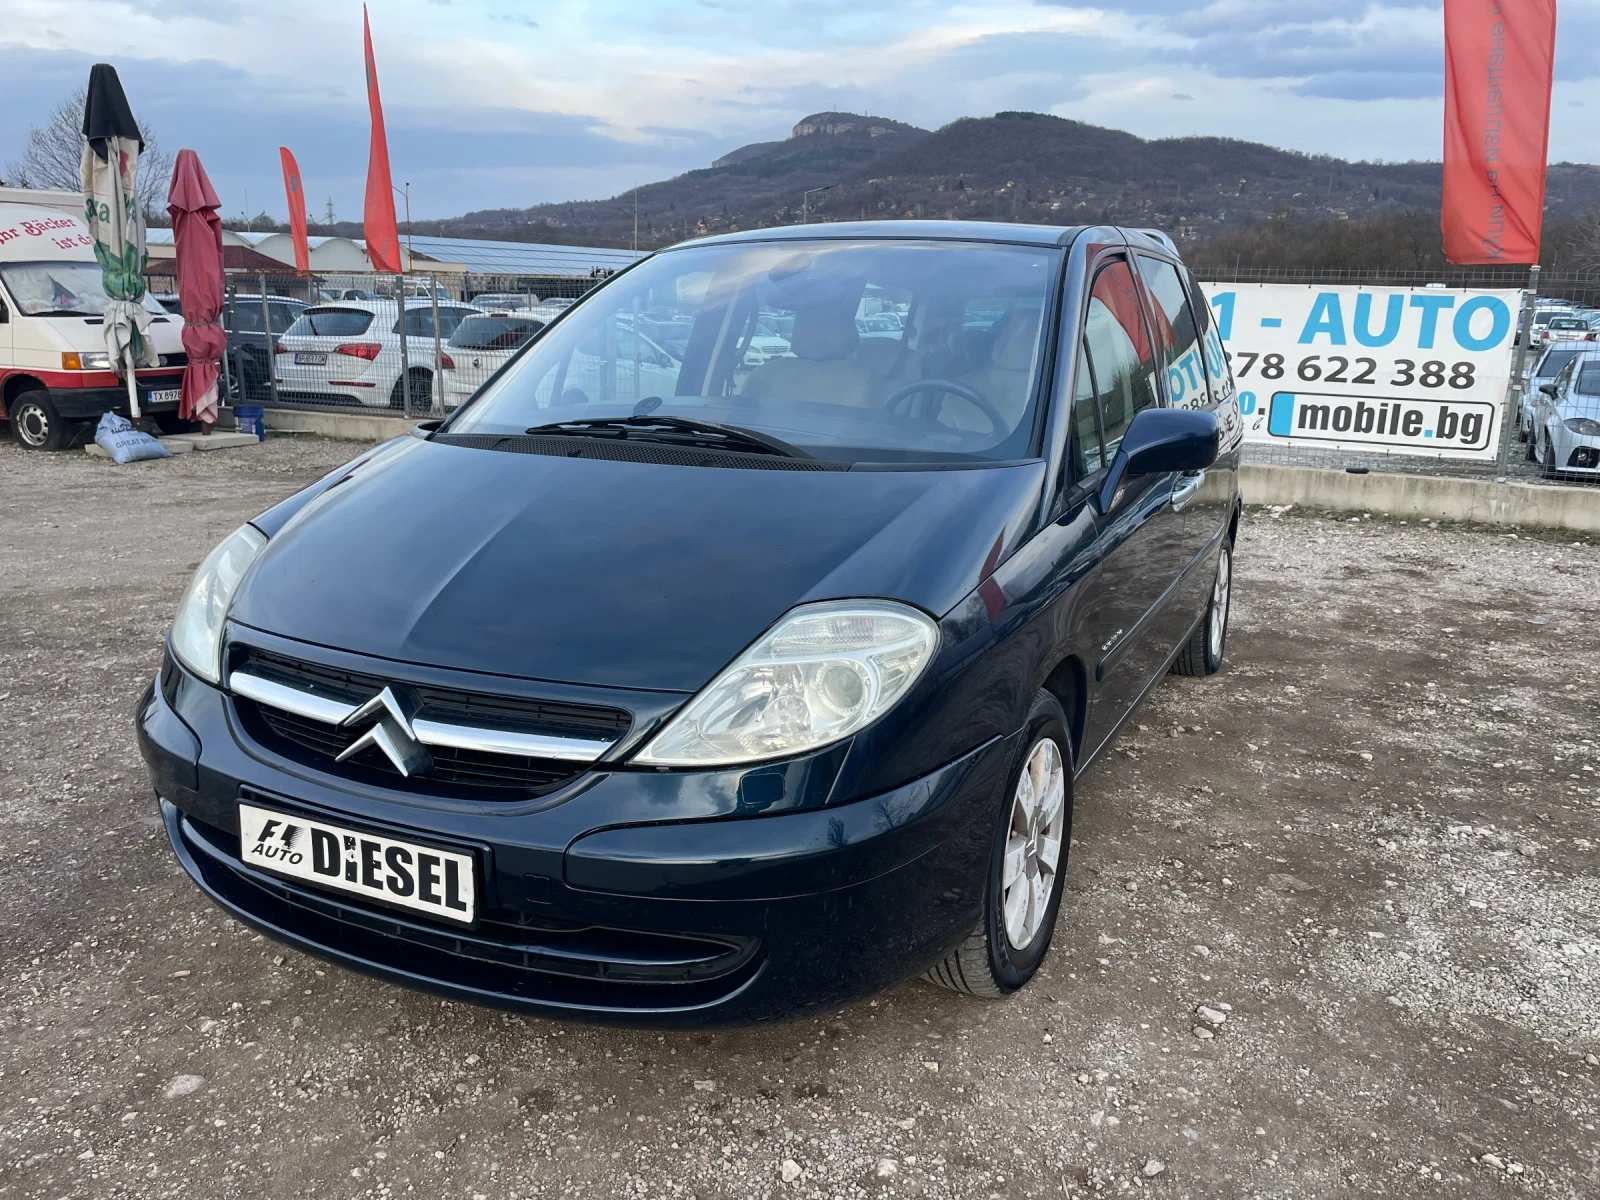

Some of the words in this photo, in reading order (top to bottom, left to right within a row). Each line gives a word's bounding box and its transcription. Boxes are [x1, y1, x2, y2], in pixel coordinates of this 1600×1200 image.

[19, 217, 77, 237] Bäcker
[51, 237, 78, 249] ist
[1297, 291, 1512, 352] AUTO
[1297, 354, 1377, 386] 622
[1390, 357, 1477, 390] 388
[1297, 400, 1485, 446] mobile.bg
[115, 438, 141, 449] GREAT
[251, 842, 304, 865] AUTO
[310, 827, 468, 913] DIESEL
